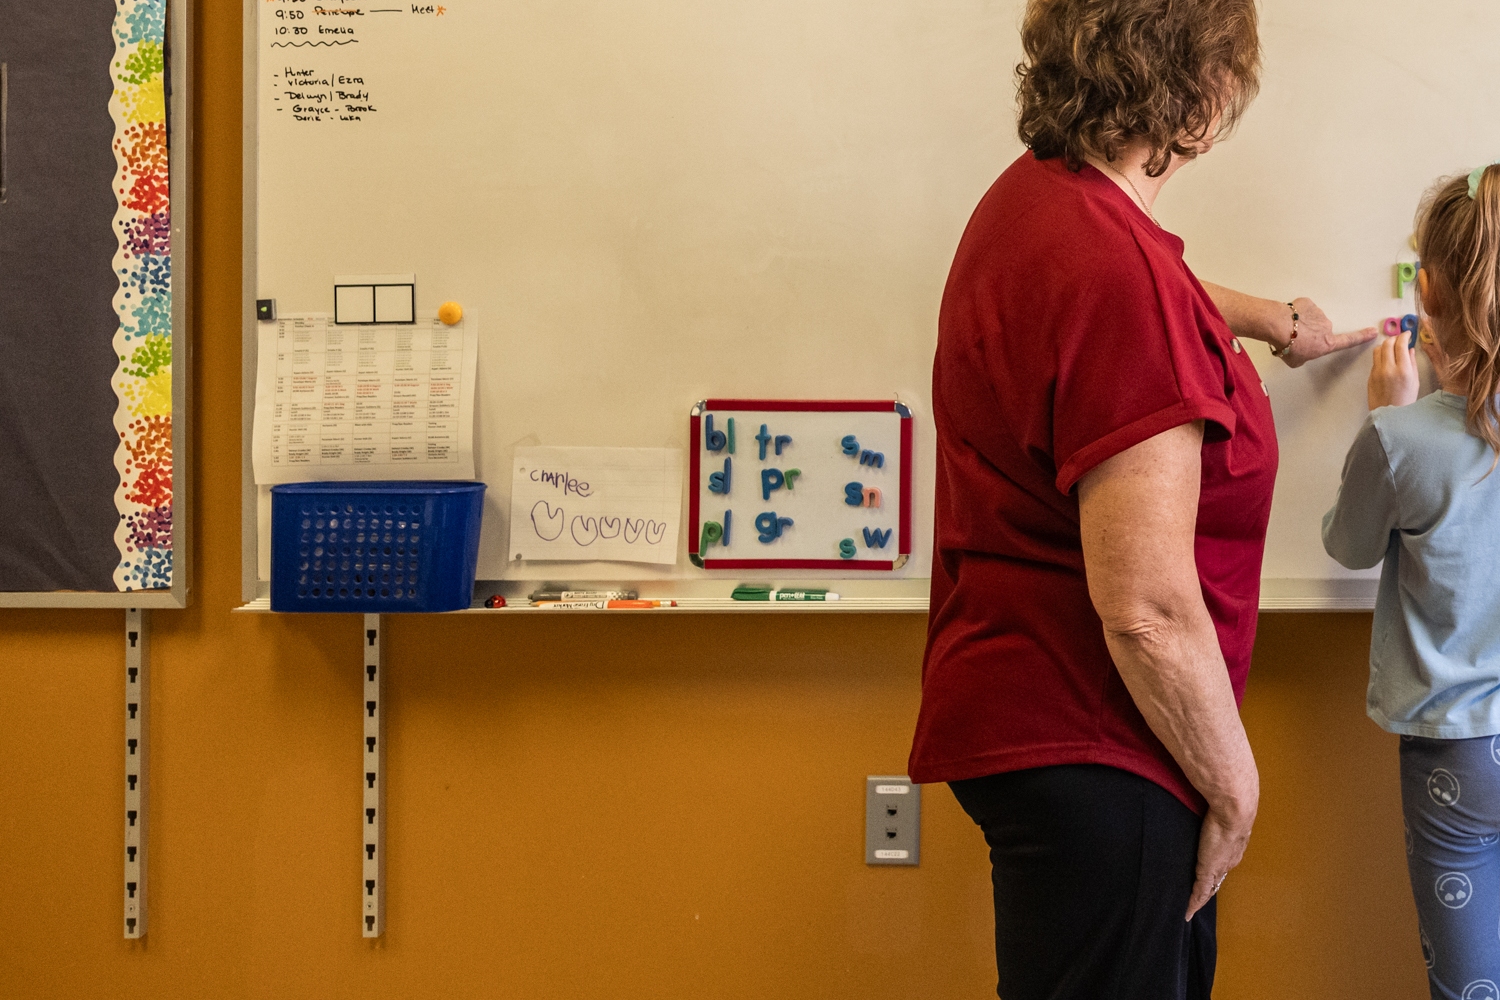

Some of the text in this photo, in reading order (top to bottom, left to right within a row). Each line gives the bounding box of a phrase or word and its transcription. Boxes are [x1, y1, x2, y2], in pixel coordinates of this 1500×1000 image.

[275, 9, 304, 20] 9:50
[275, 26, 308, 36] 10:30
[705, 414, 885, 468] bl tr sm
[761, 468, 801, 500] pr
[844, 482, 882, 508] sn
[700, 509, 732, 557] pl
[755, 511, 794, 543] gr
